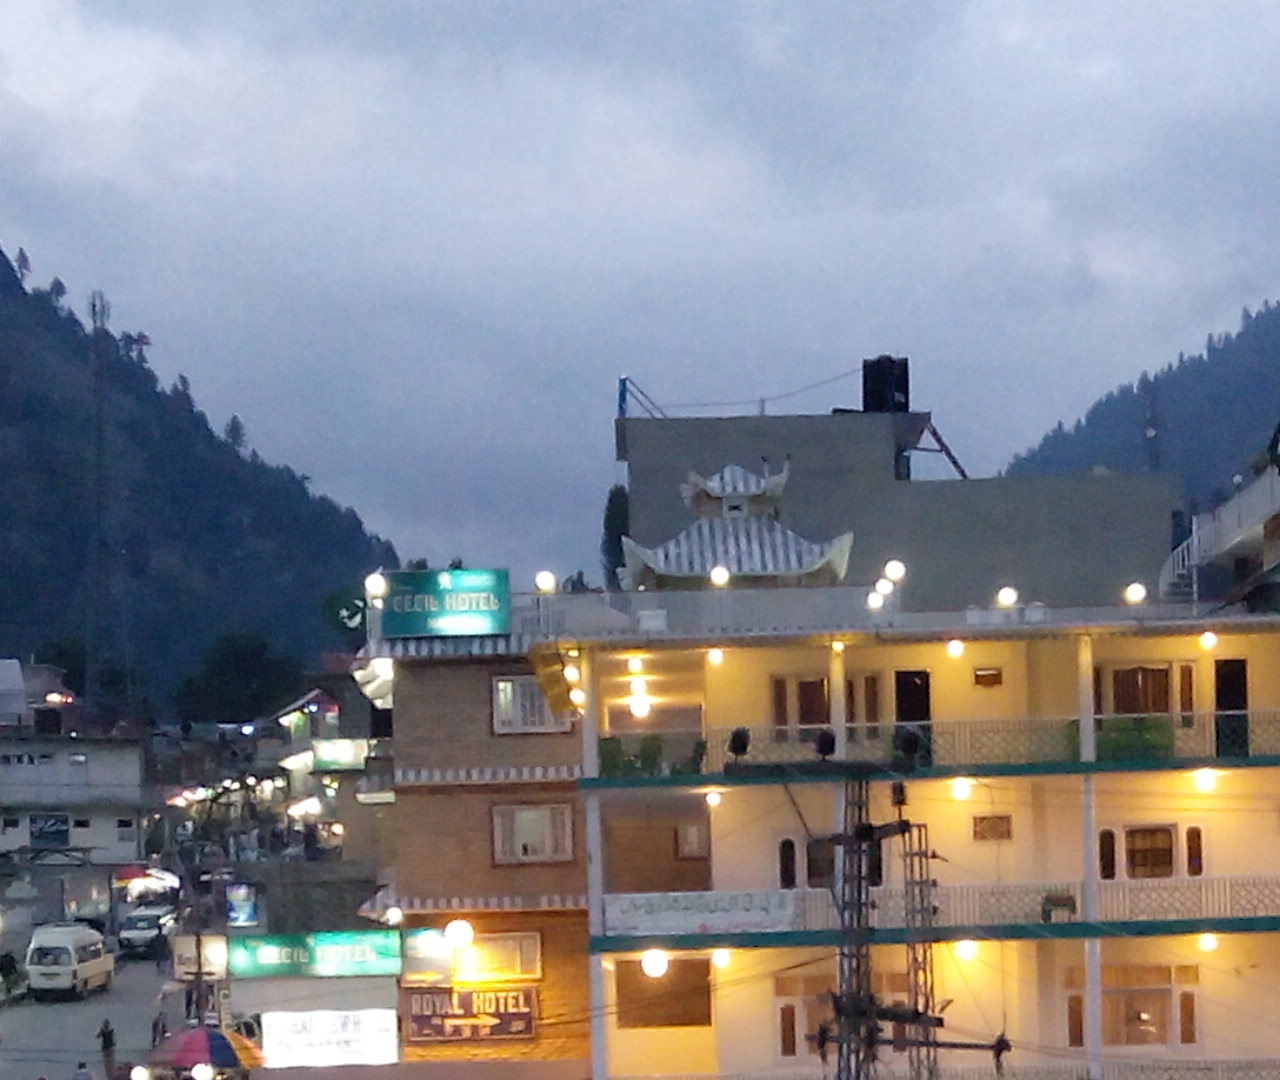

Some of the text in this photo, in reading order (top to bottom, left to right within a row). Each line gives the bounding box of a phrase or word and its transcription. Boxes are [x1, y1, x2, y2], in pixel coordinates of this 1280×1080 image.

[392, 591, 501, 612] CECIL HOTEL
[411, 990, 531, 1016] ROYAL HOTEL
